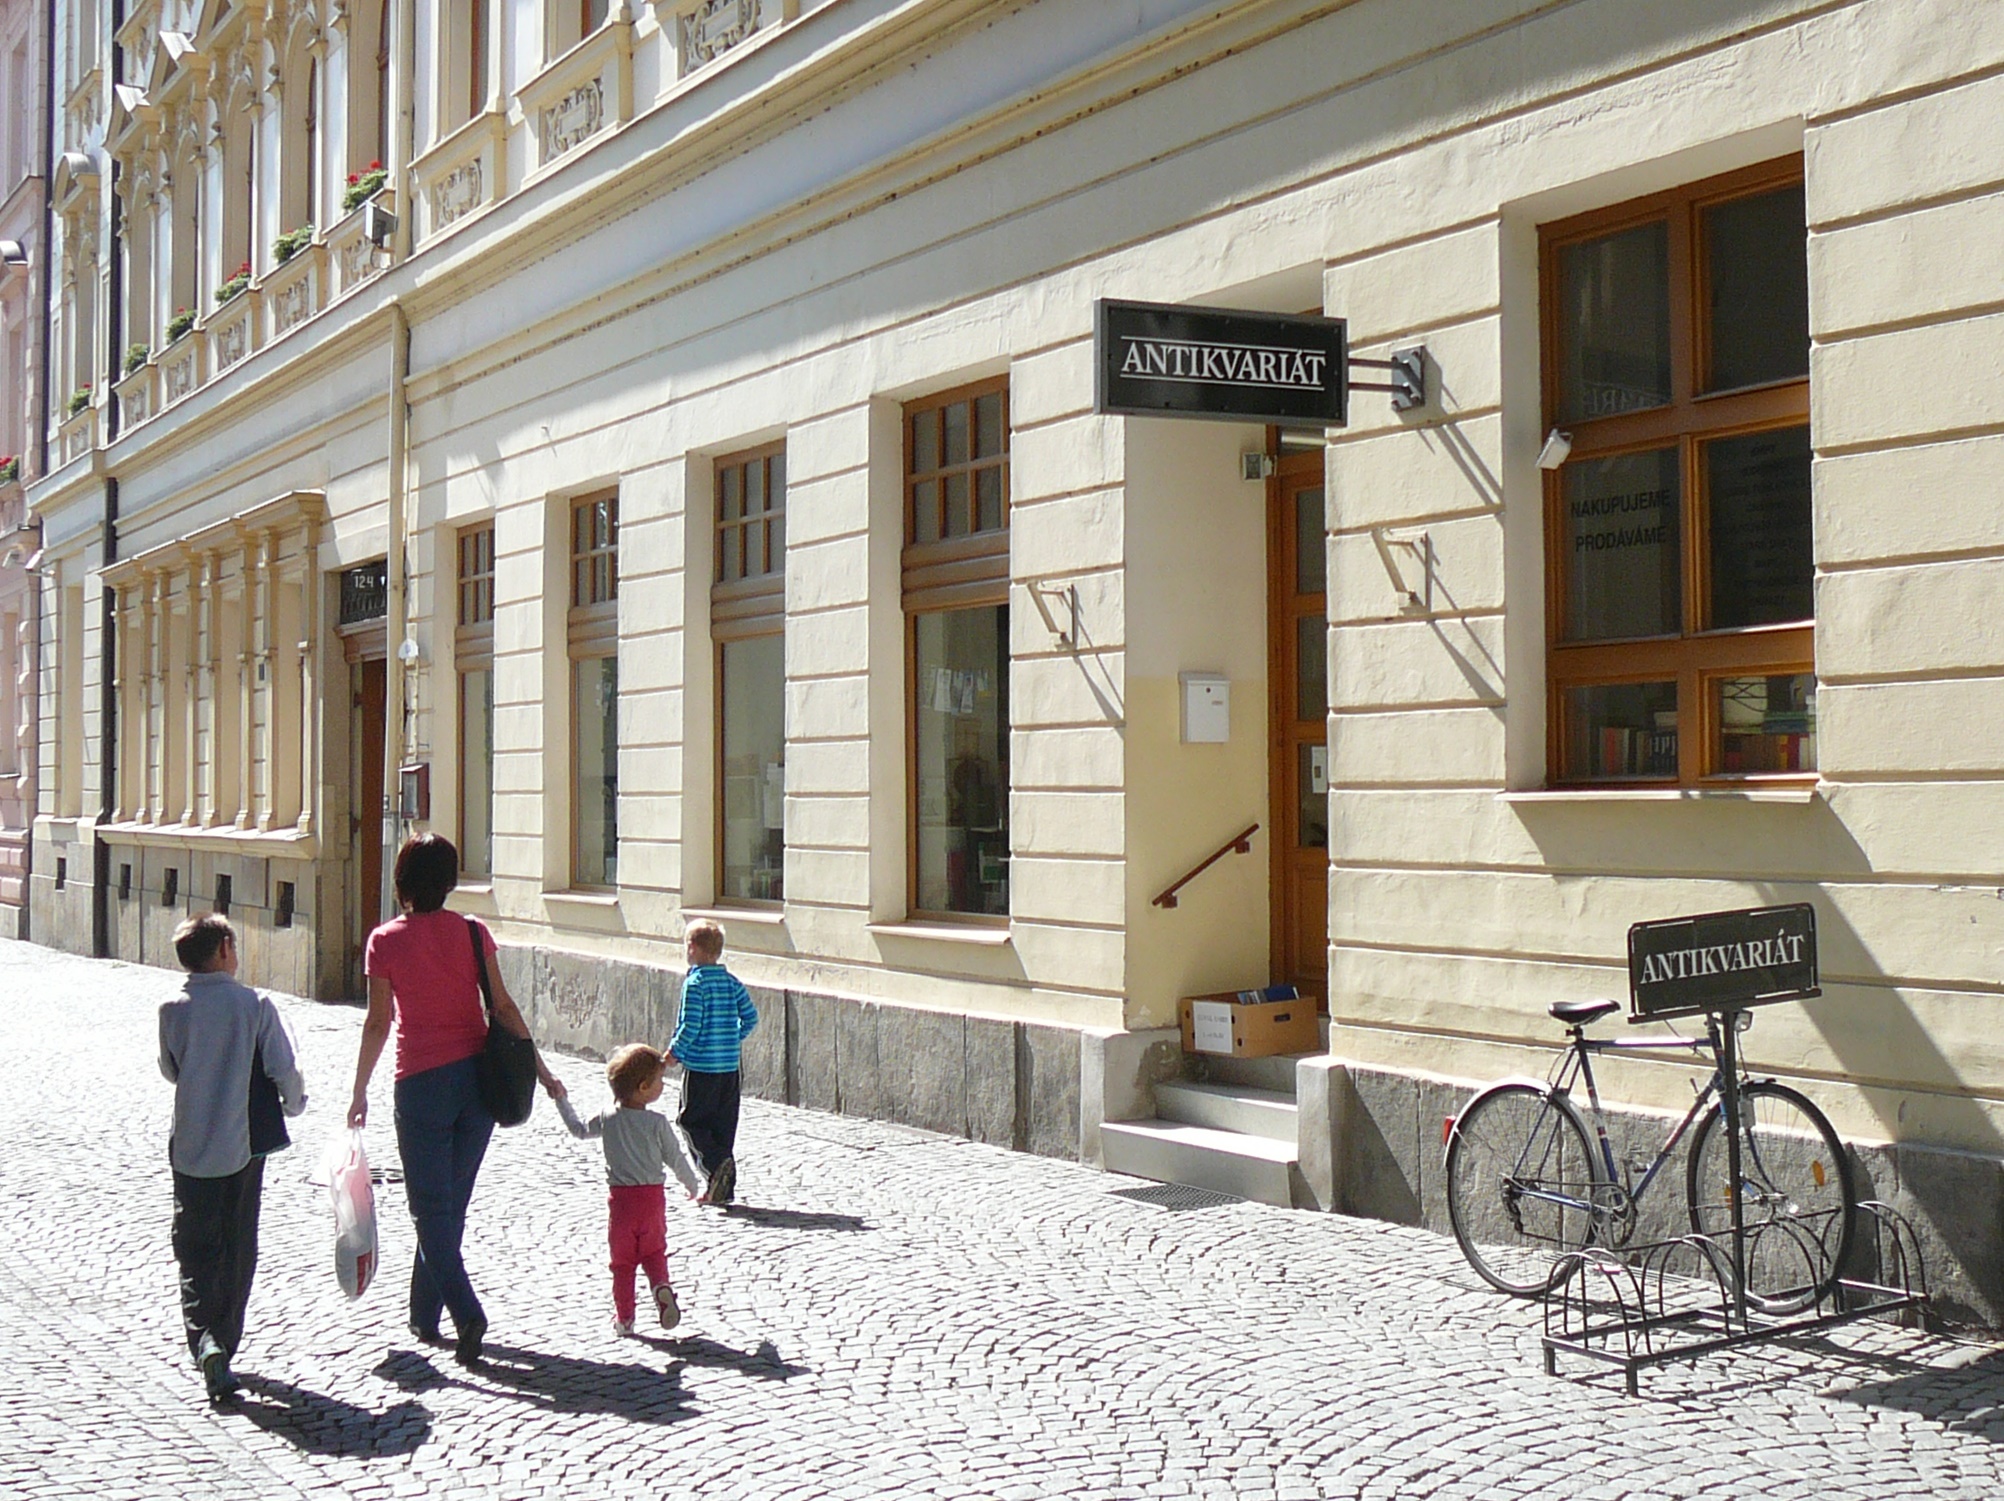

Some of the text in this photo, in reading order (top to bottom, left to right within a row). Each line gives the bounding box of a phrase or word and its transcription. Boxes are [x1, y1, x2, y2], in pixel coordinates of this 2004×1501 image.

[1120, 341, 1326, 386] ANTIKVARIÁT
[1571, 489, 1671, 517] NAKUPUJEME
[354, 575, 375, 589] 124
[1640, 928, 1805, 984] ANTIKVARIÁT
